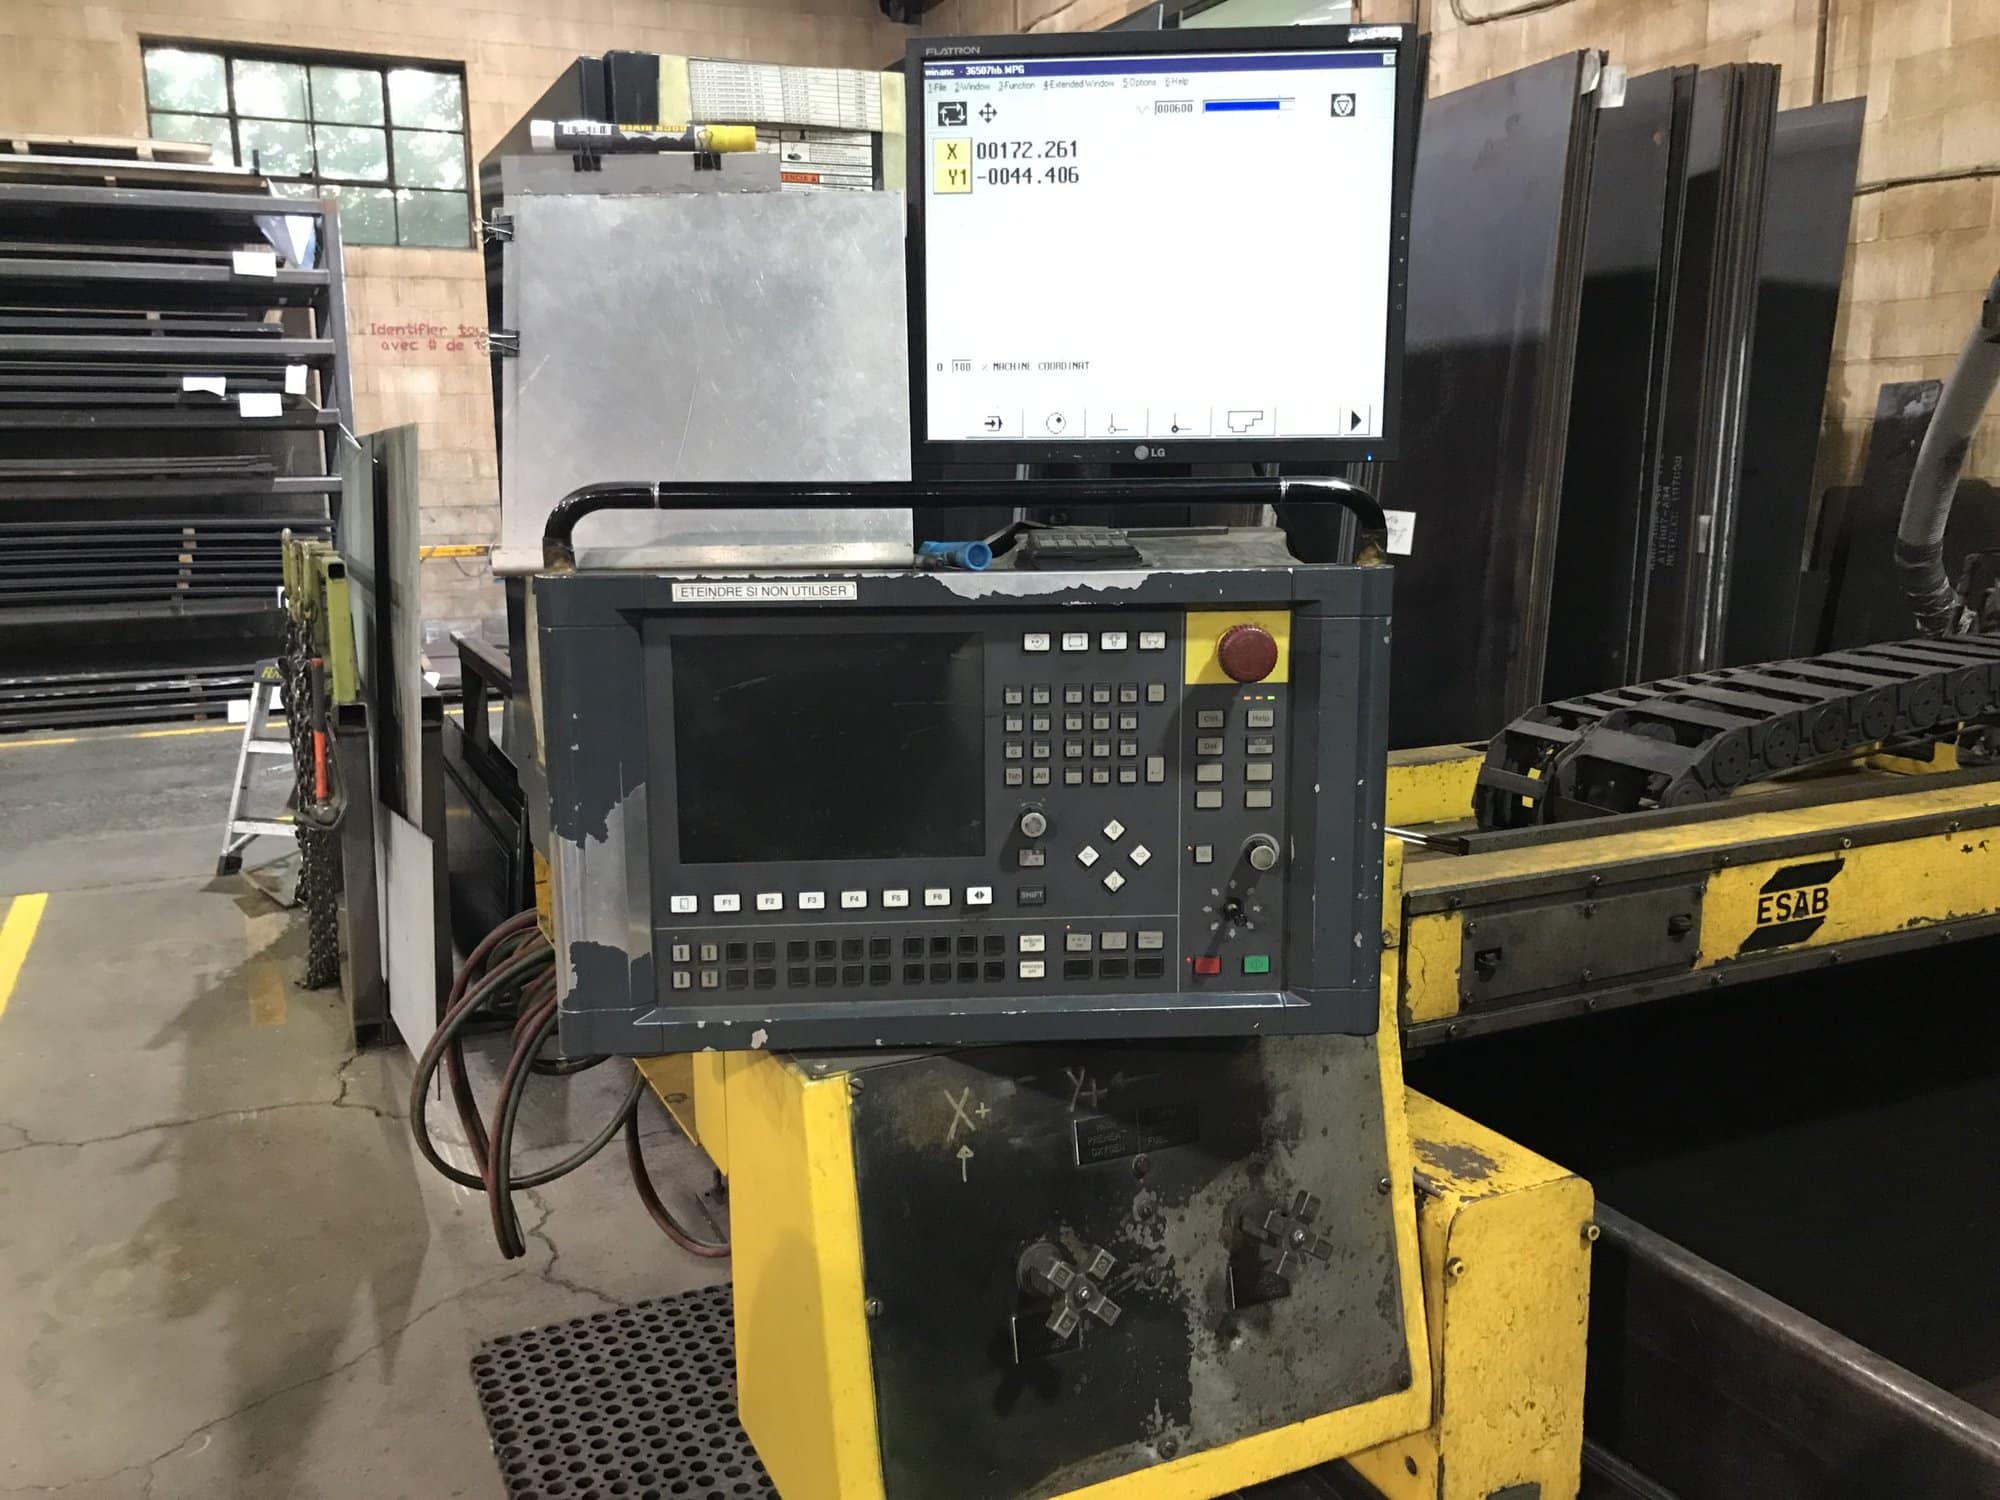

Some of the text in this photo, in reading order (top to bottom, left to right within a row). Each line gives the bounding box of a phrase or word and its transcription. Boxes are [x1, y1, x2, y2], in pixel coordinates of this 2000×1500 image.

[926, 46, 981, 56] FLATRON
[1085, 79, 1115, 88] Window
[1157, 103, 1193, 114] 000600
[947, 140, 1078, 160] X 00172.261
[948, 166, 1080, 186] Y1 -0044.406
[371, 322, 448, 337] Identifier
[381, 339, 419, 351] avec
[446, 338, 465, 352] de
[936, 362, 944, 373] 0
[954, 362, 972, 372] 100
[992, 361, 1031, 372] MACHINE
[1037, 360, 1091, 371] COORDINAT
[1151, 447, 1166, 458] LG
[680, 584, 847, 599] ETEINDRE SI NON UTILISER
[1020, 890, 1043, 900] SHIFT
[1756, 887, 1830, 925] ESAB
